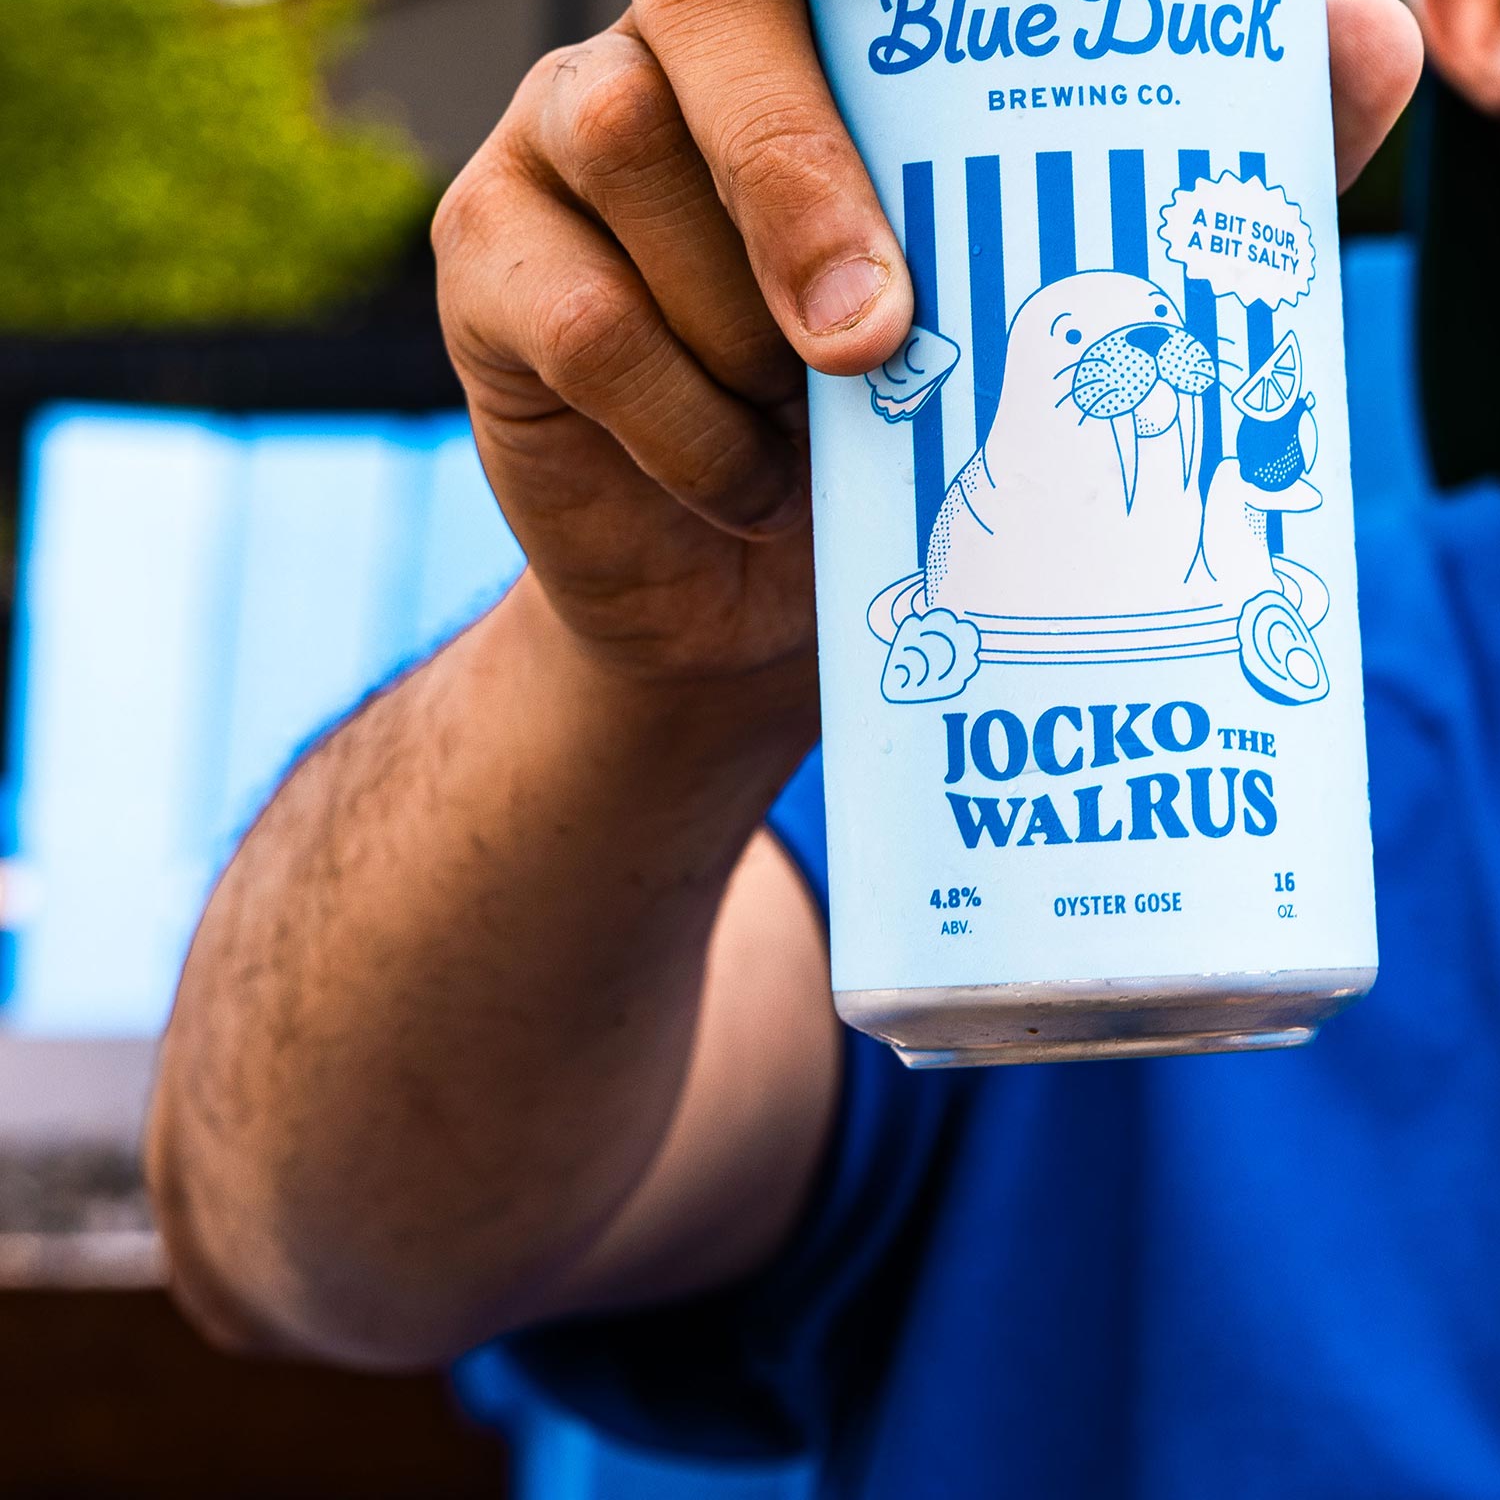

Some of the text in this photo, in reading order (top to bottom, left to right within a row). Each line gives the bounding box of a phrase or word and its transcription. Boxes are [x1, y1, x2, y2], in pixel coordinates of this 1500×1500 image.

[988, 83, 1182, 112] BREWING CO.
[1192, 208, 1299, 256] A BIT SOUR,
[1187, 231, 1300, 275] A BIT SALTY
[942, 700, 1277, 784] JOCKO THE
[944, 766, 1278, 850] WALRUS
[1273, 871, 1296, 893] 16
[929, 886, 982, 910] 4.8%
[1053, 891, 1183, 918] OYSTER GOSE
[1277, 903, 1298, 919] OZ.
[940, 919, 973, 936] ABV.
